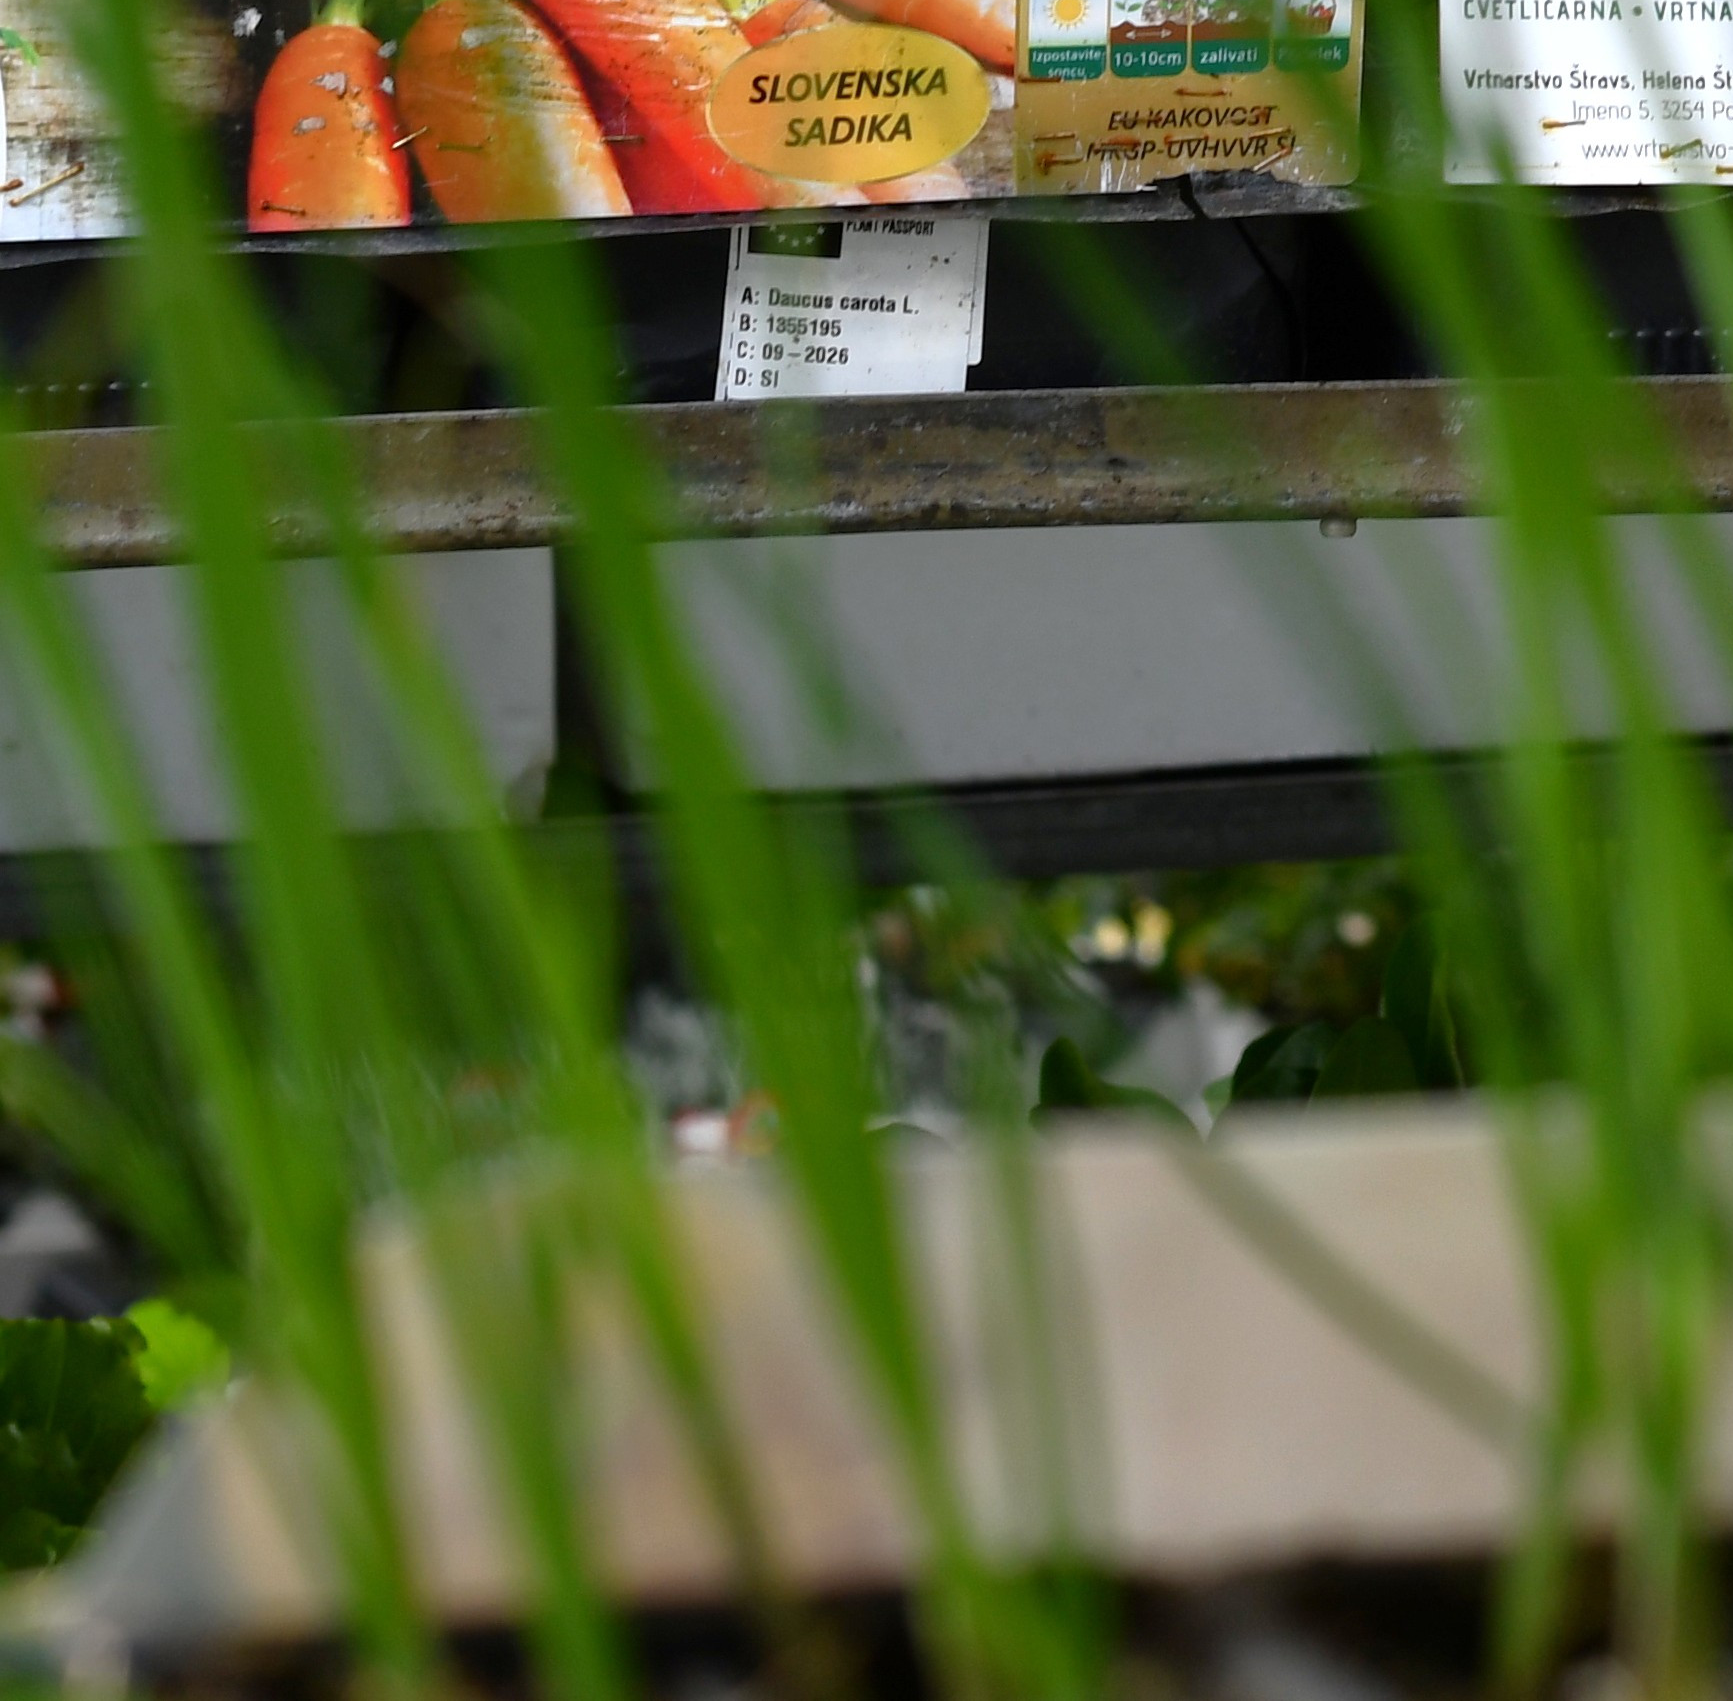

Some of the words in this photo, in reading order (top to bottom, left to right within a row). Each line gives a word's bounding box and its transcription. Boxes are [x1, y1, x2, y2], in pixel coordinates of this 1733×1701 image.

[1114, 51, 1183, 68] 10-10cm
[749, 67, 948, 104] SLOVENSKA
[1464, 68, 1562, 90] Vrtnarstvo
[1569, 63, 1635, 92] Štravs,
[1642, 70, 1706, 90] Helena
[1572, 100, 1632, 121] Imeno
[1661, 100, 1704, 121] 3254
[784, 113, 912, 148] SADIKA
[741, 287, 760, 306] A:
[767, 288, 833, 310] Daucus
[840, 295, 896, 312] carota
[902, 296, 919, 315] L.
[739, 313, 757, 333] B:
[737, 341, 754, 360] C:
[734, 368, 752, 387] D:
[760, 370, 779, 388] SI
